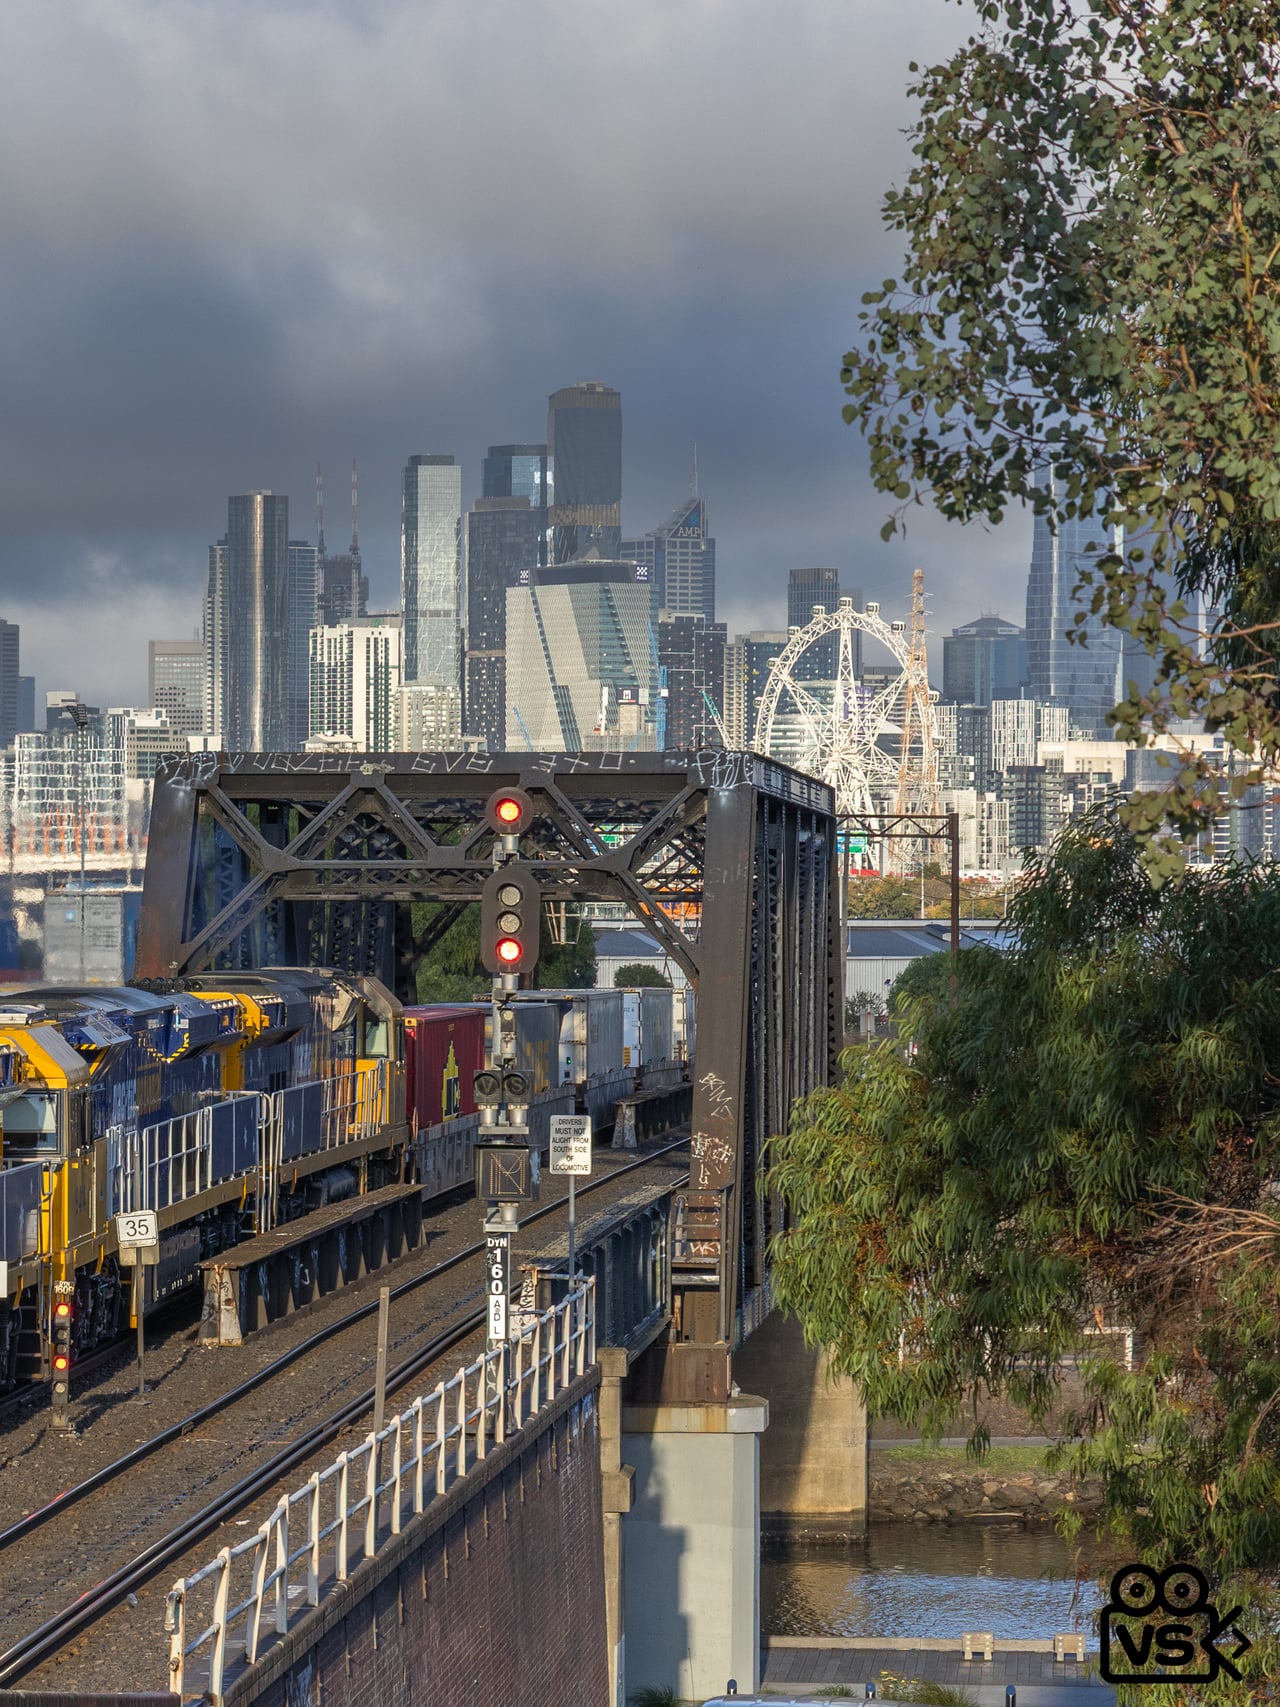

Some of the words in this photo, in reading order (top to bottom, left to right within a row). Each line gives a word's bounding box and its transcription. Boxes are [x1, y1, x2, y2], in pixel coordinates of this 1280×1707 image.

[677, 526, 700, 537] AMP
[558, 1118, 583, 1126] DRIVERS
[554, 1127, 572, 1135] MUST
[573, 1127, 586, 1135] NOT
[125, 1218, 150, 1238] 35
[487, 1238, 508, 1248] DYN
